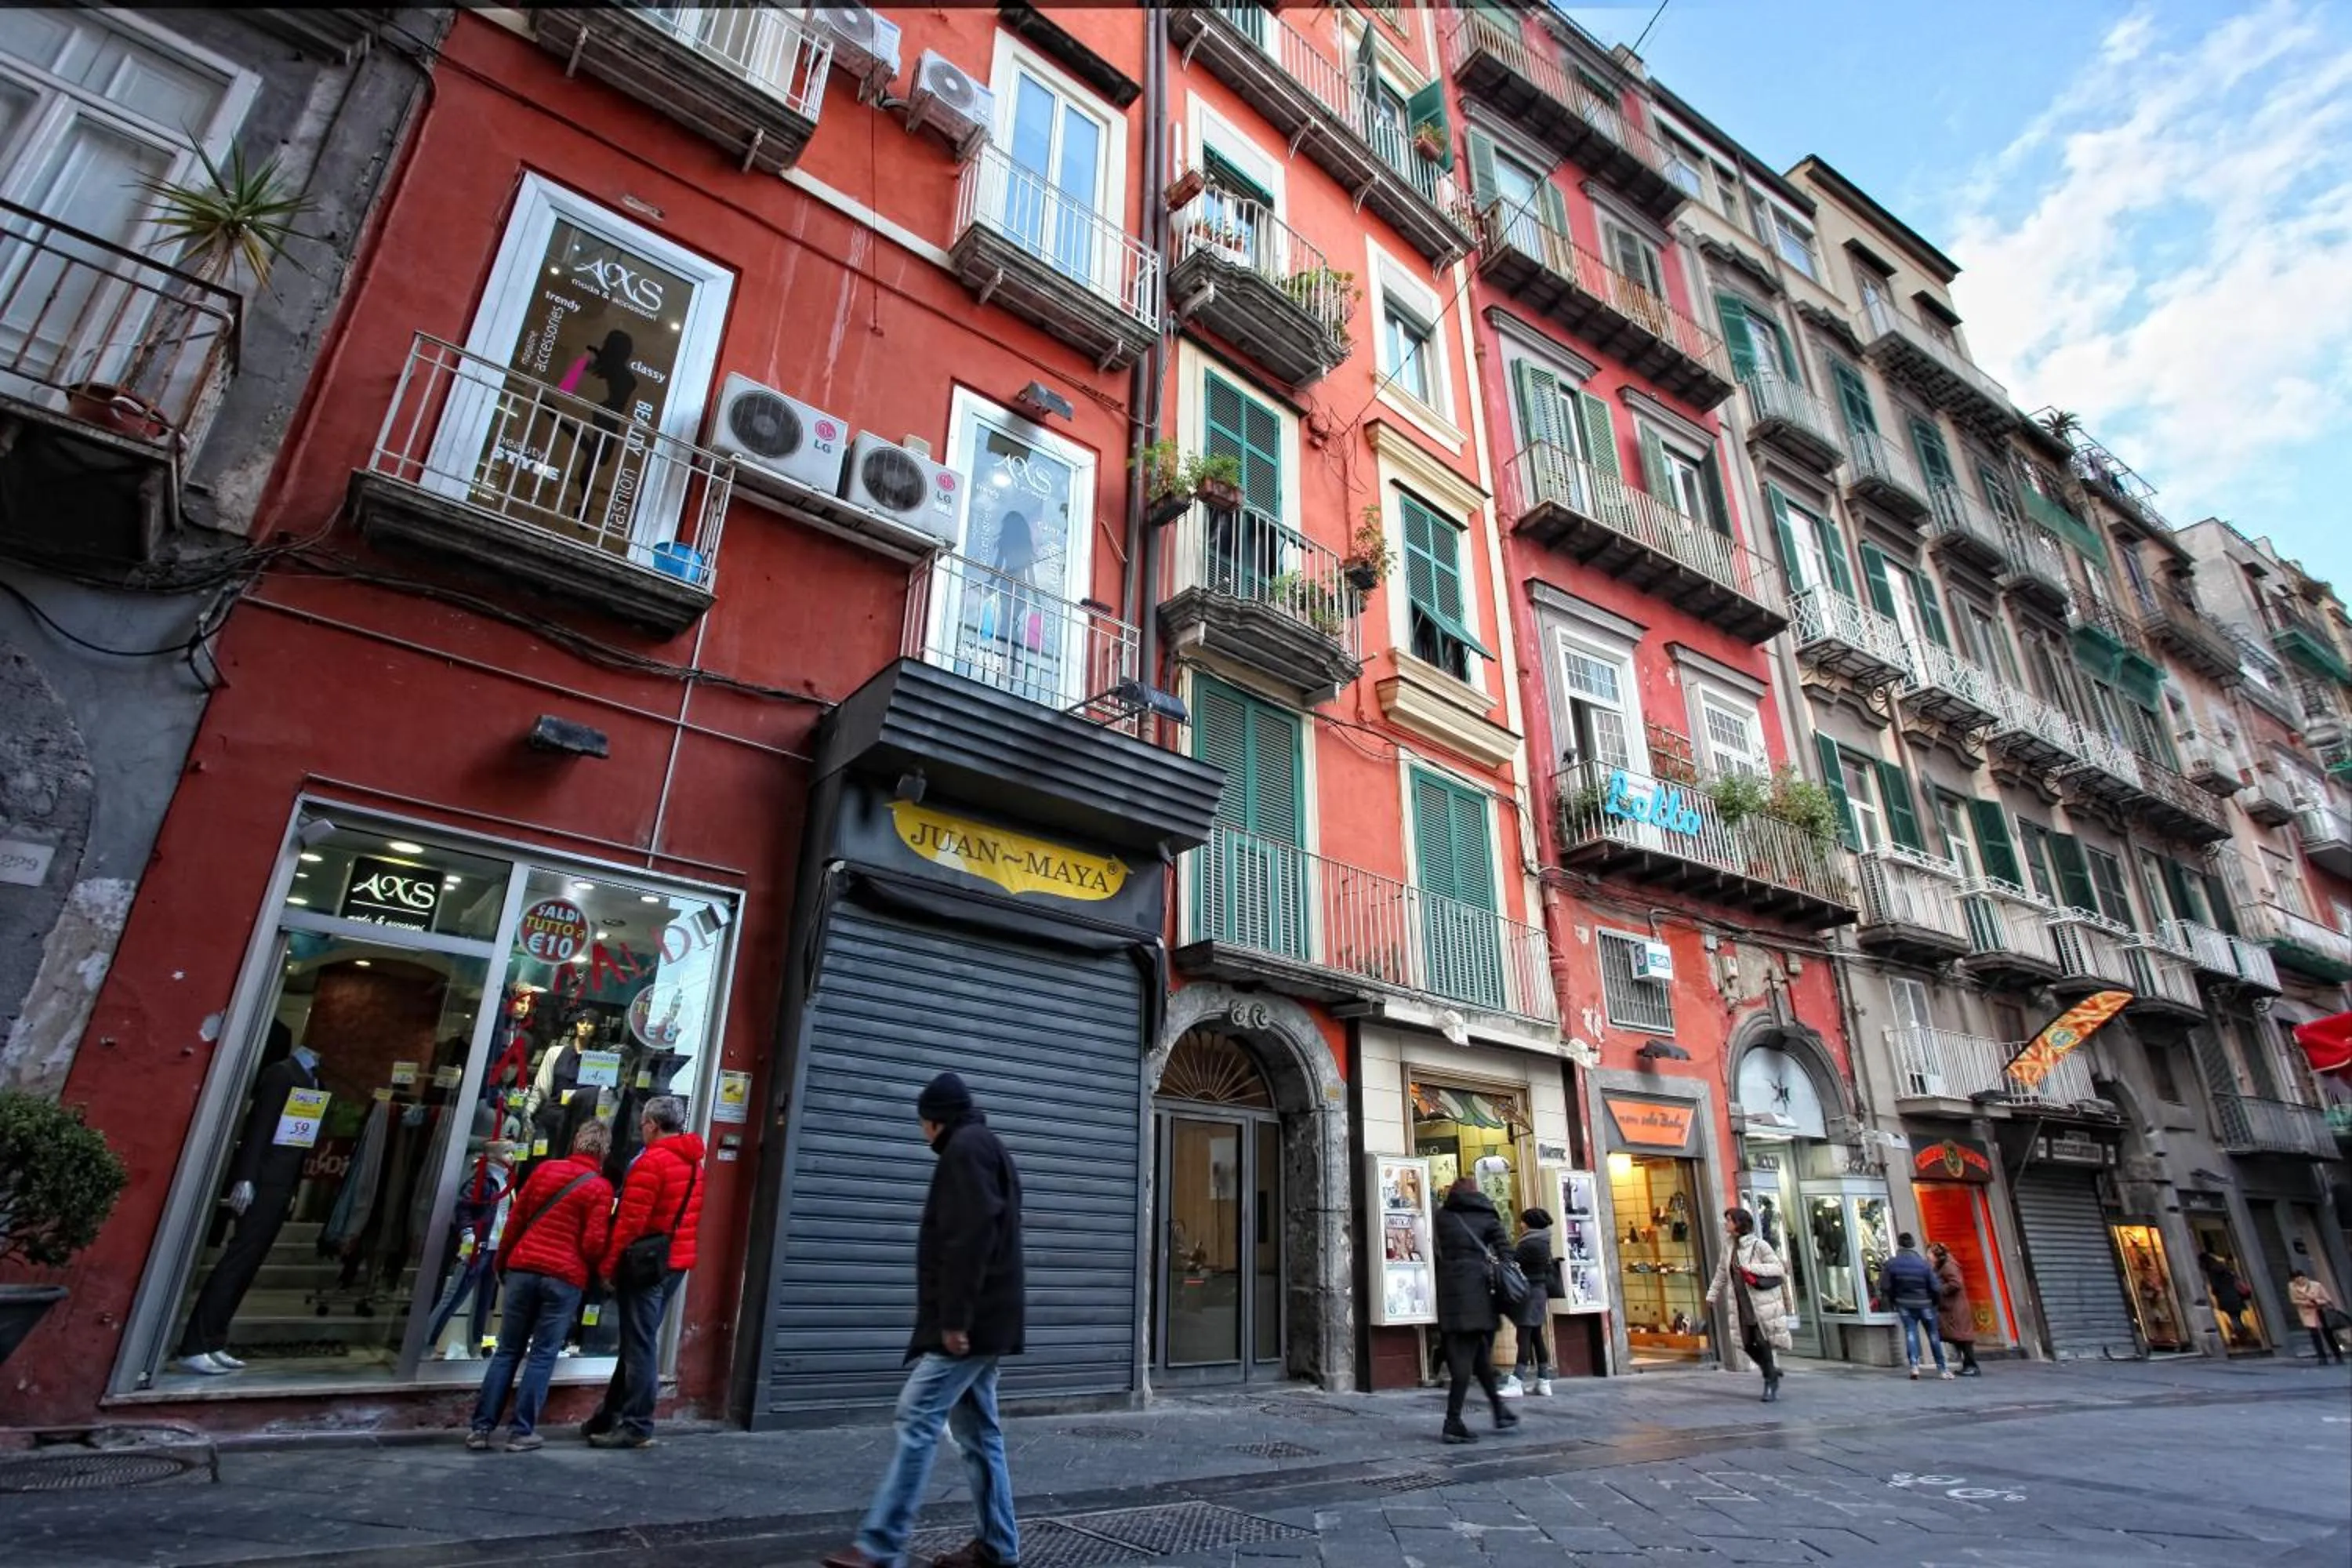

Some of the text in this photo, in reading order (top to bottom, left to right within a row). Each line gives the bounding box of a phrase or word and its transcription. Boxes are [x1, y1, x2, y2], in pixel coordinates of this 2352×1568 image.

[574, 258, 663, 311] AXS
[545, 290, 581, 312] trendy
[534, 305, 564, 372] accessories
[630, 360, 666, 383] classy
[814, 439, 832, 455] LG
[937, 491, 953, 505] LG
[352, 873, 435, 909] AXS
[527, 916, 575, 935] TUTTO
[536, 905, 580, 924] SALDI
[528, 933, 573, 958] €10
